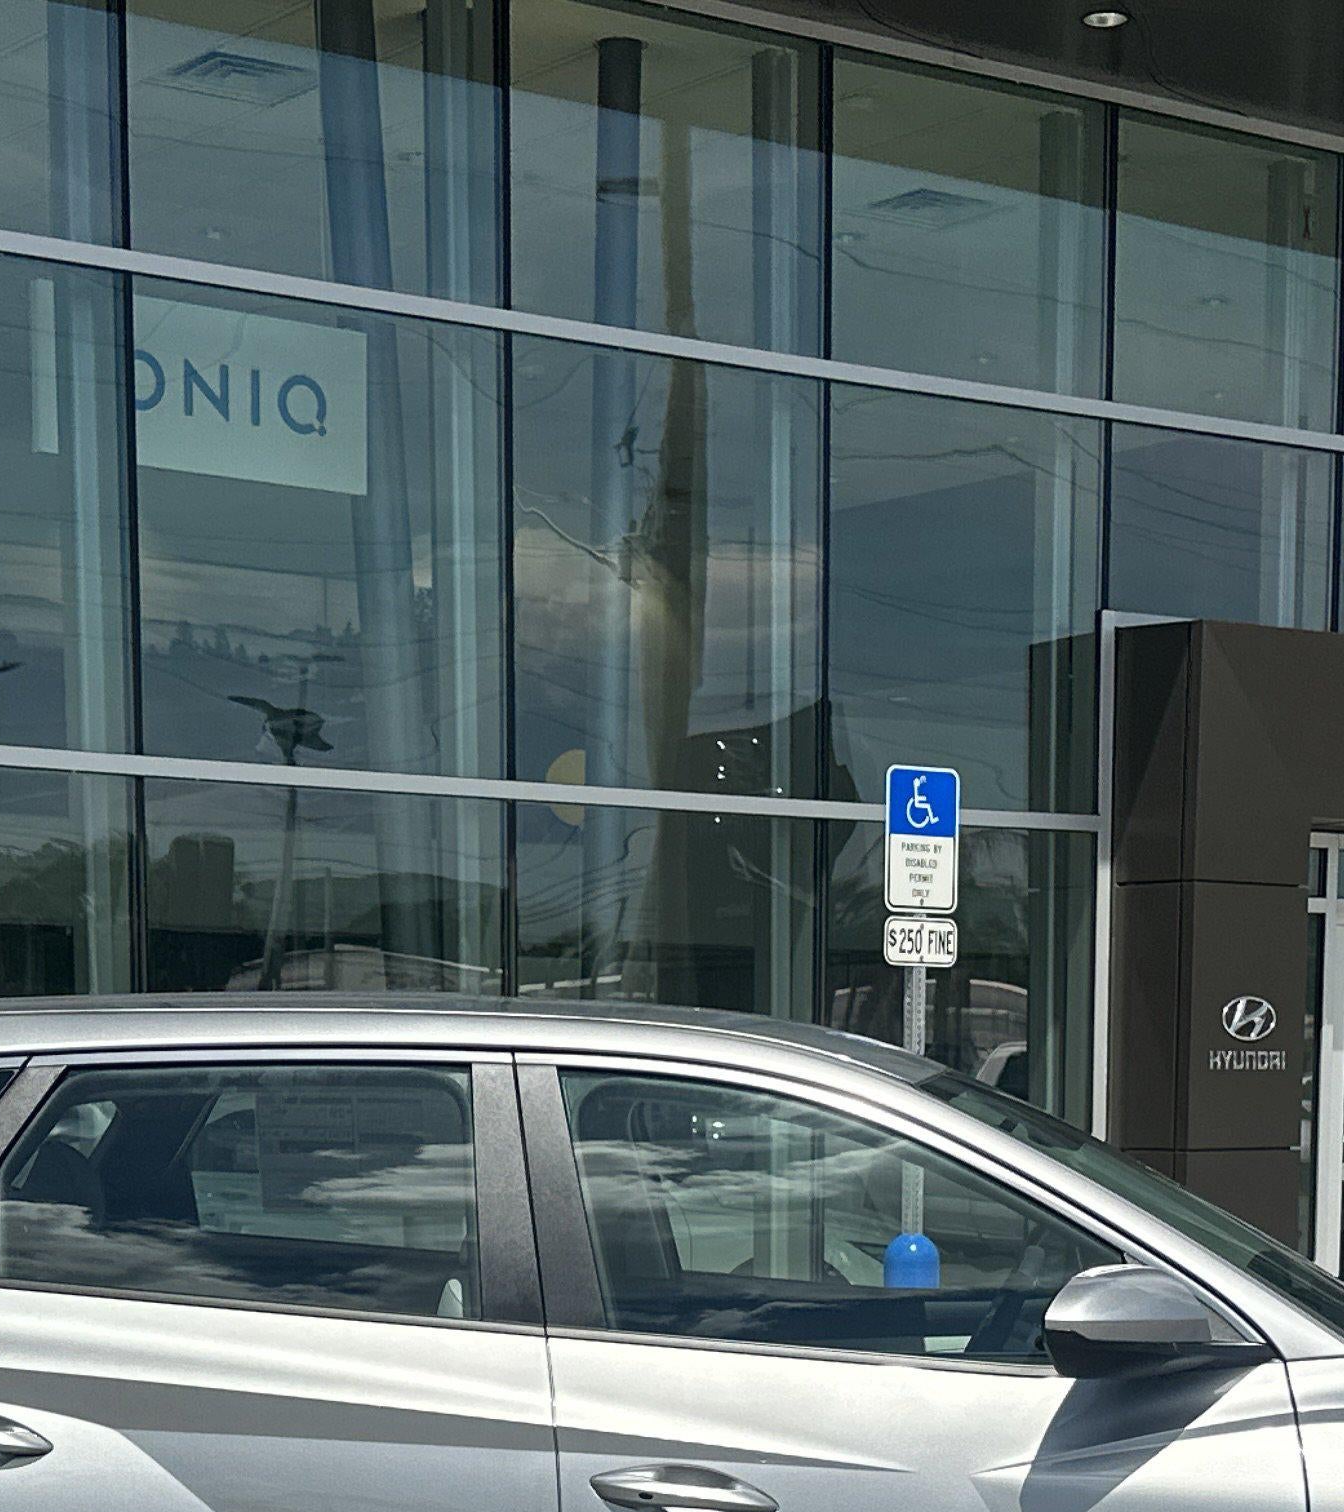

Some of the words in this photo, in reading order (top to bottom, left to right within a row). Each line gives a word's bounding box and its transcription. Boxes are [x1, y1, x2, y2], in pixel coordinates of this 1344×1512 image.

[888, 928, 923, 955] $250
[927, 929, 955, 955] FINE
[1209, 1050, 1286, 1071] HYUNDAI
